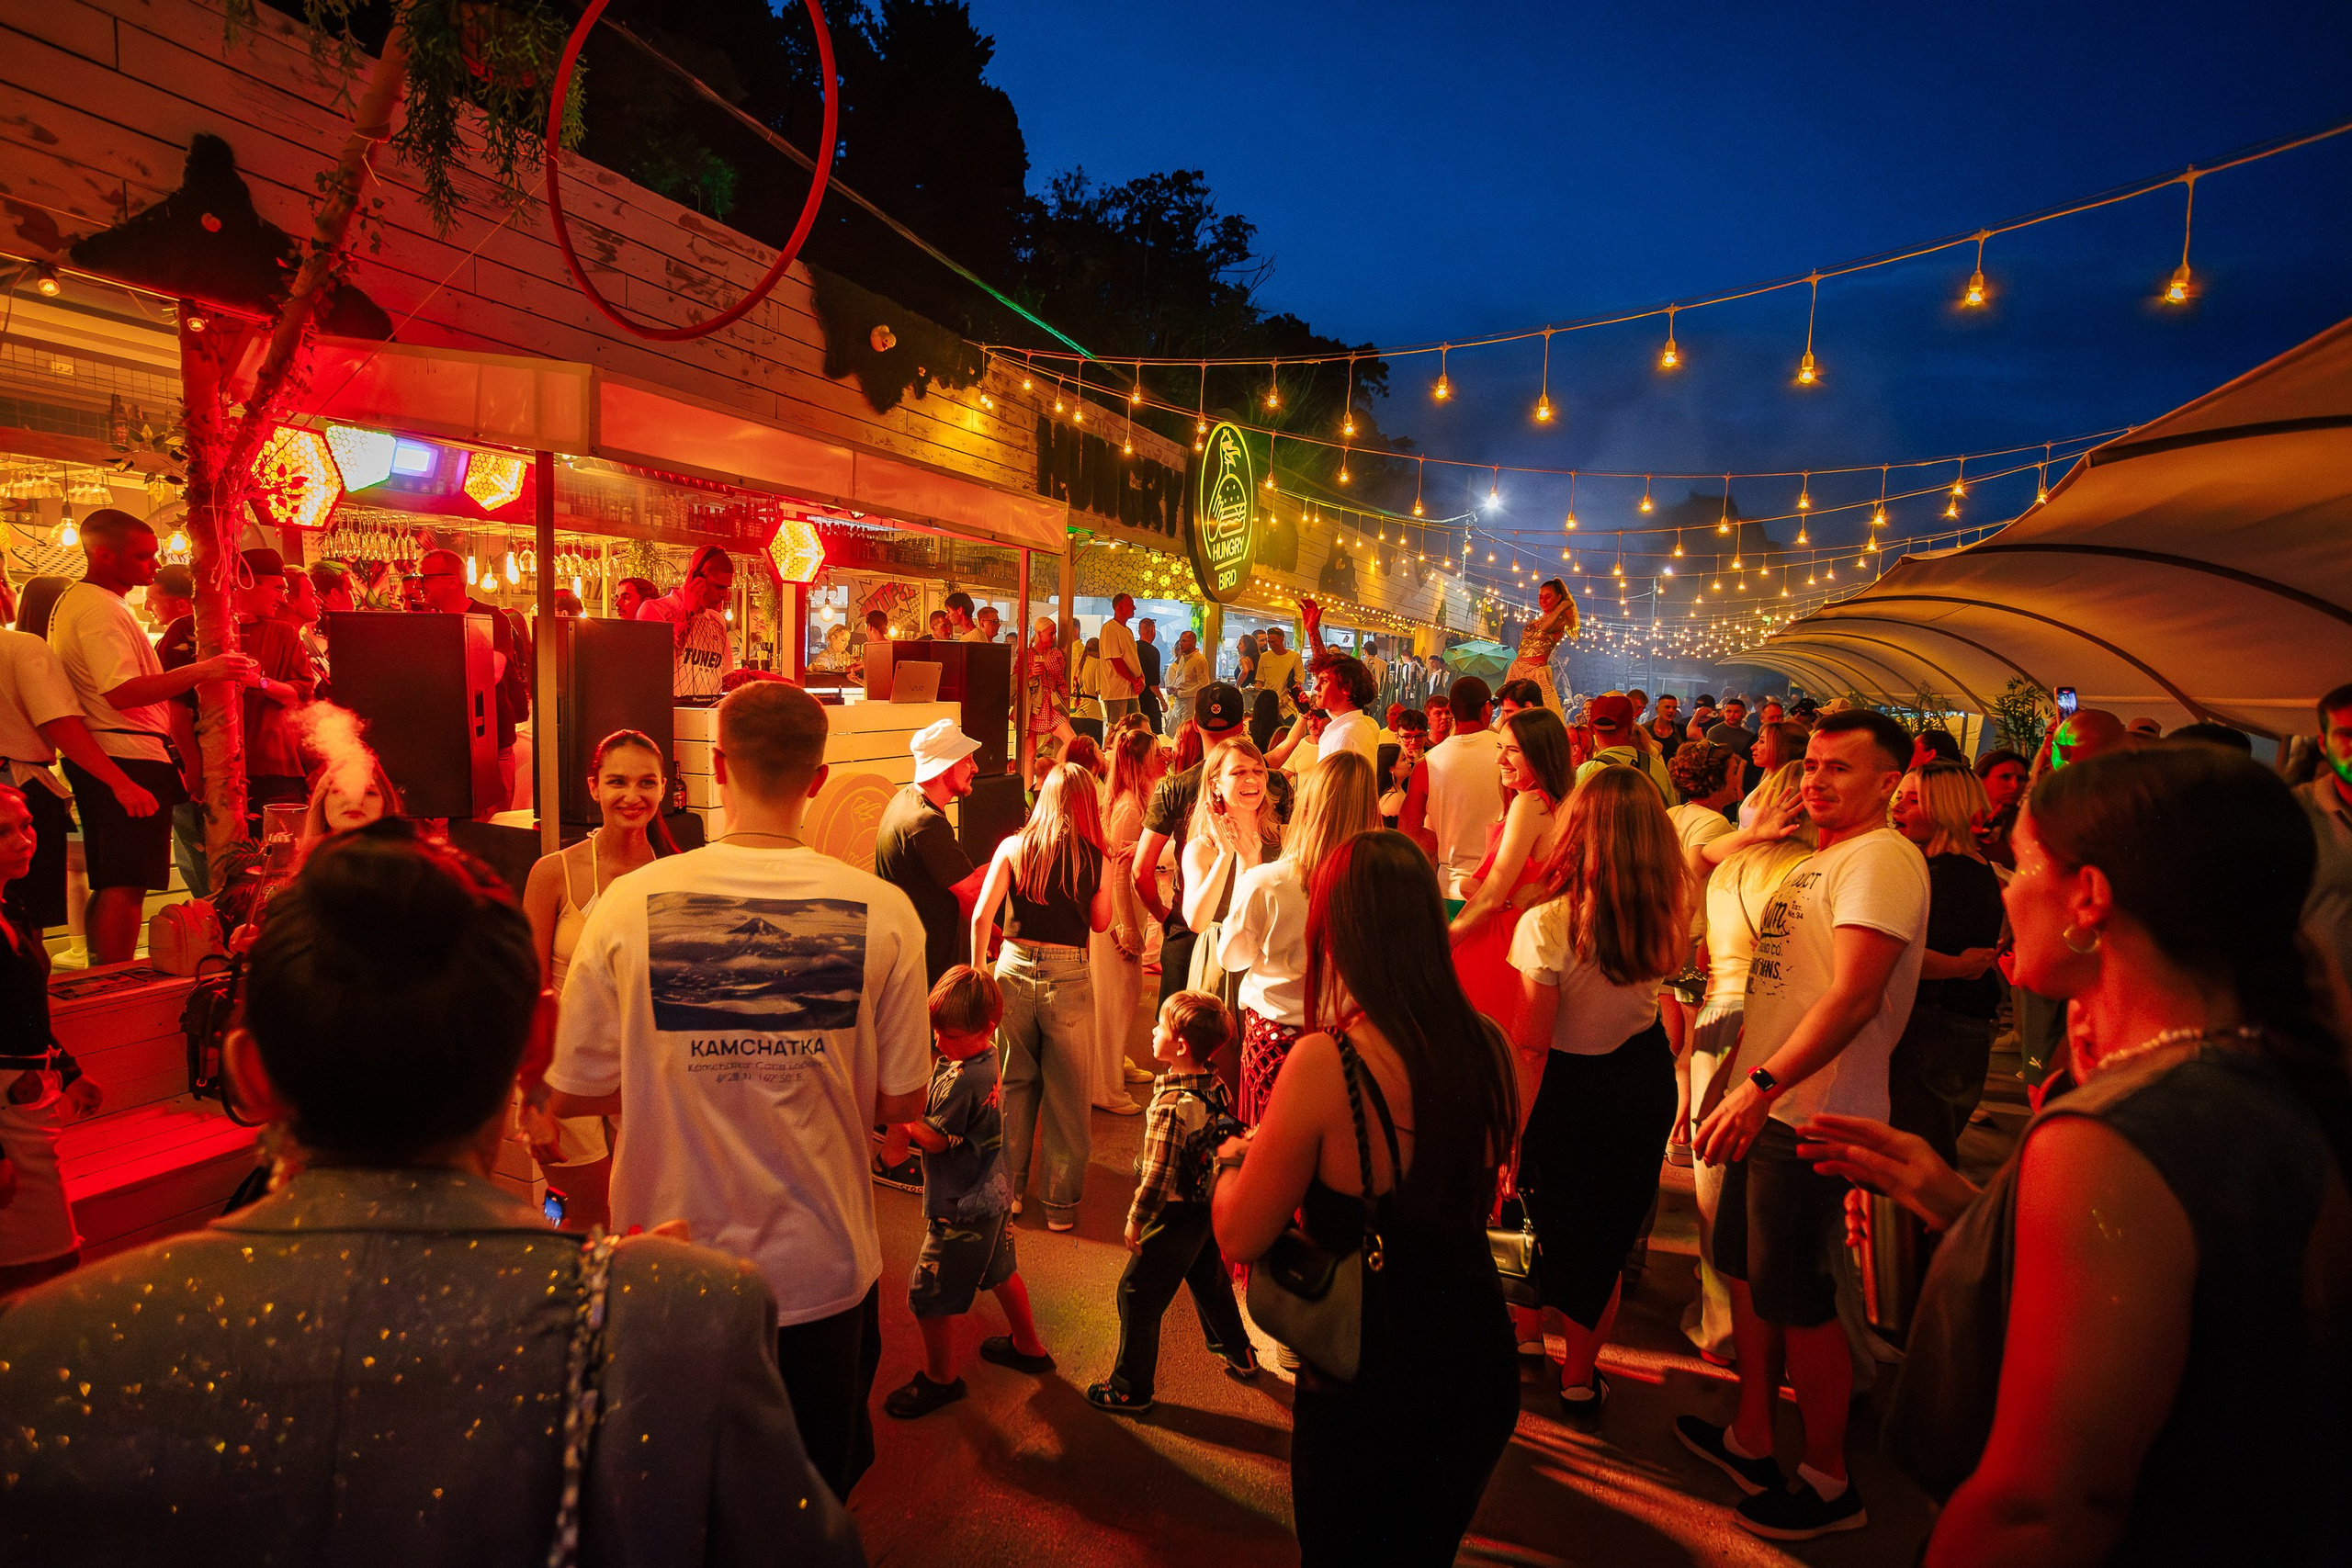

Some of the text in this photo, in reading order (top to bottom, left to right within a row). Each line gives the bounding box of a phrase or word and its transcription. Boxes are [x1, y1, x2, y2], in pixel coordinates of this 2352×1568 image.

[1212, 536, 1244, 562] HUNGRY
[1218, 569, 1237, 591] BIRD
[683, 647, 723, 669] TUNED
[691, 1037, 825, 1056] KAMCHATKA
[899, 1184, 924, 1193] croc
